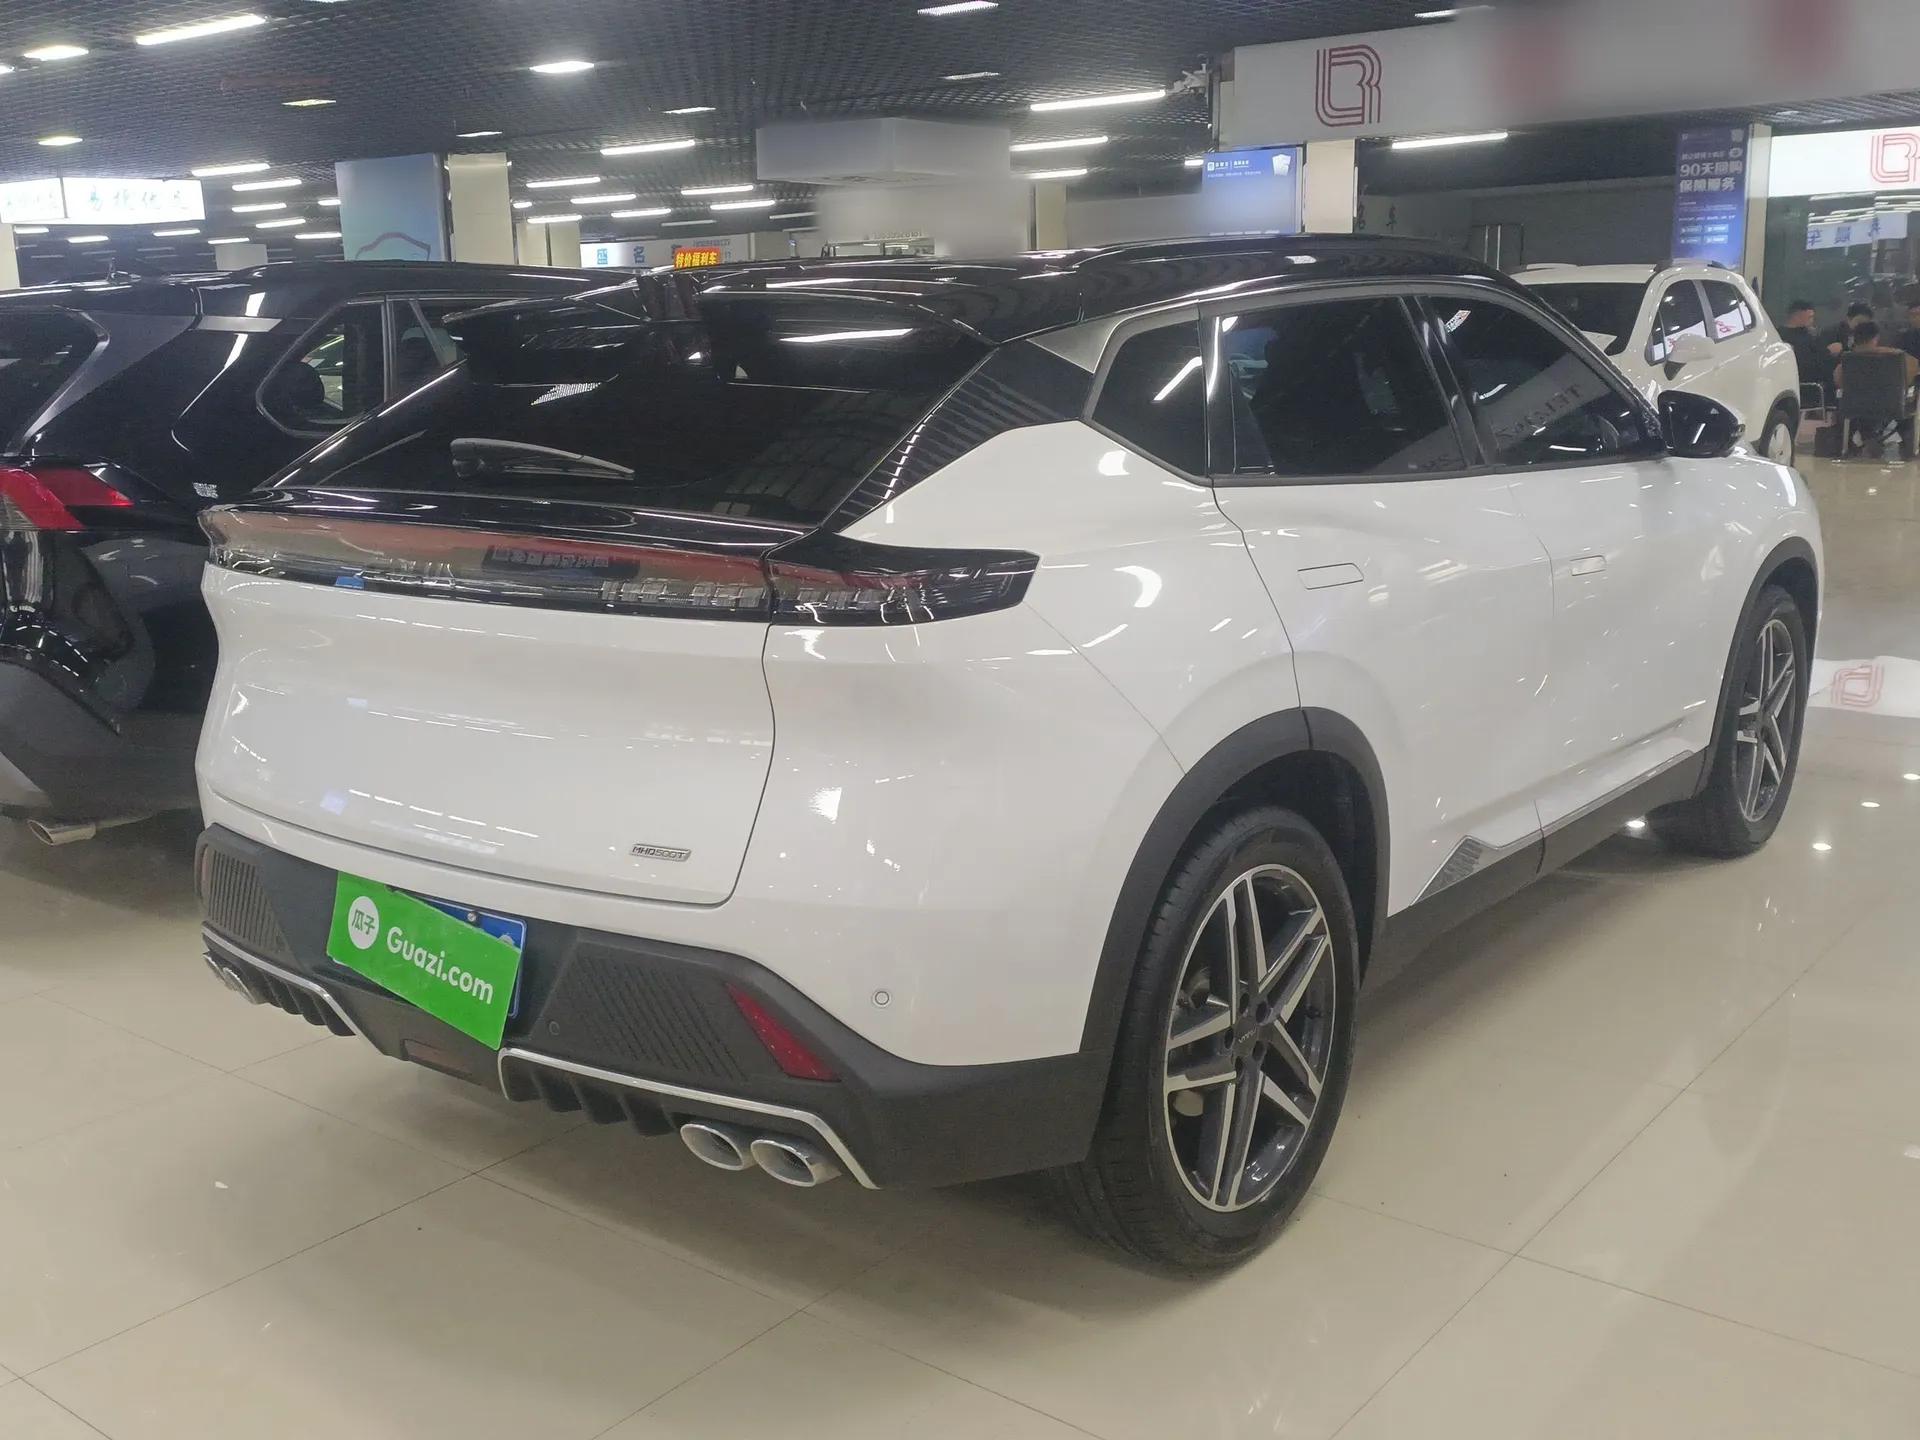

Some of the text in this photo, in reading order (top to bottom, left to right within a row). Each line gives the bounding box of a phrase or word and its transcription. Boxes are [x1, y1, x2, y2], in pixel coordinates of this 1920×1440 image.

[675, 251, 718, 268] 特价福利车
[351, 909, 376, 936] 瓜子
[386, 926, 494, 1005] Guazi.com
